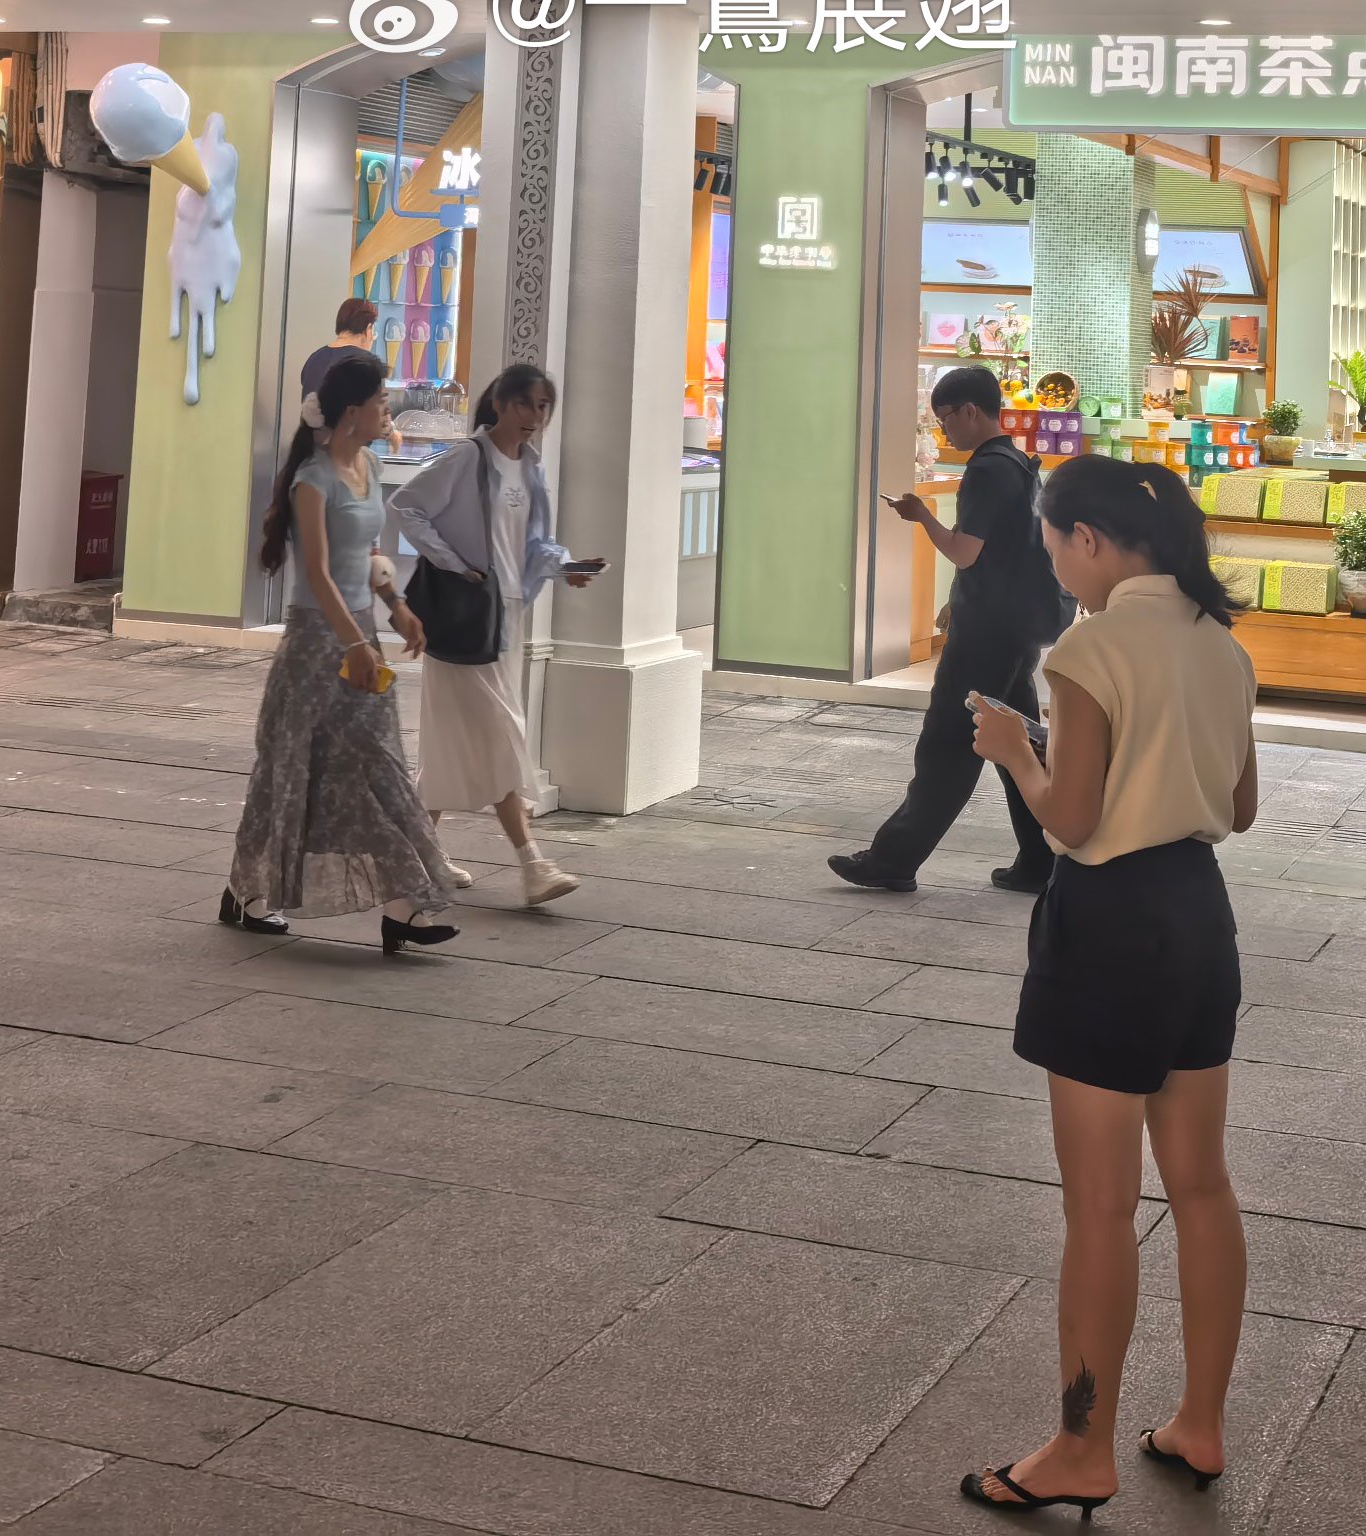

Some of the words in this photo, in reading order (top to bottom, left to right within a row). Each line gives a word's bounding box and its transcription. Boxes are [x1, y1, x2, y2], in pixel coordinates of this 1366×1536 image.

[1025, 43, 1071, 63] MIN
[1024, 65, 1075, 85] NAN
[438, 147, 482, 190] 冰
